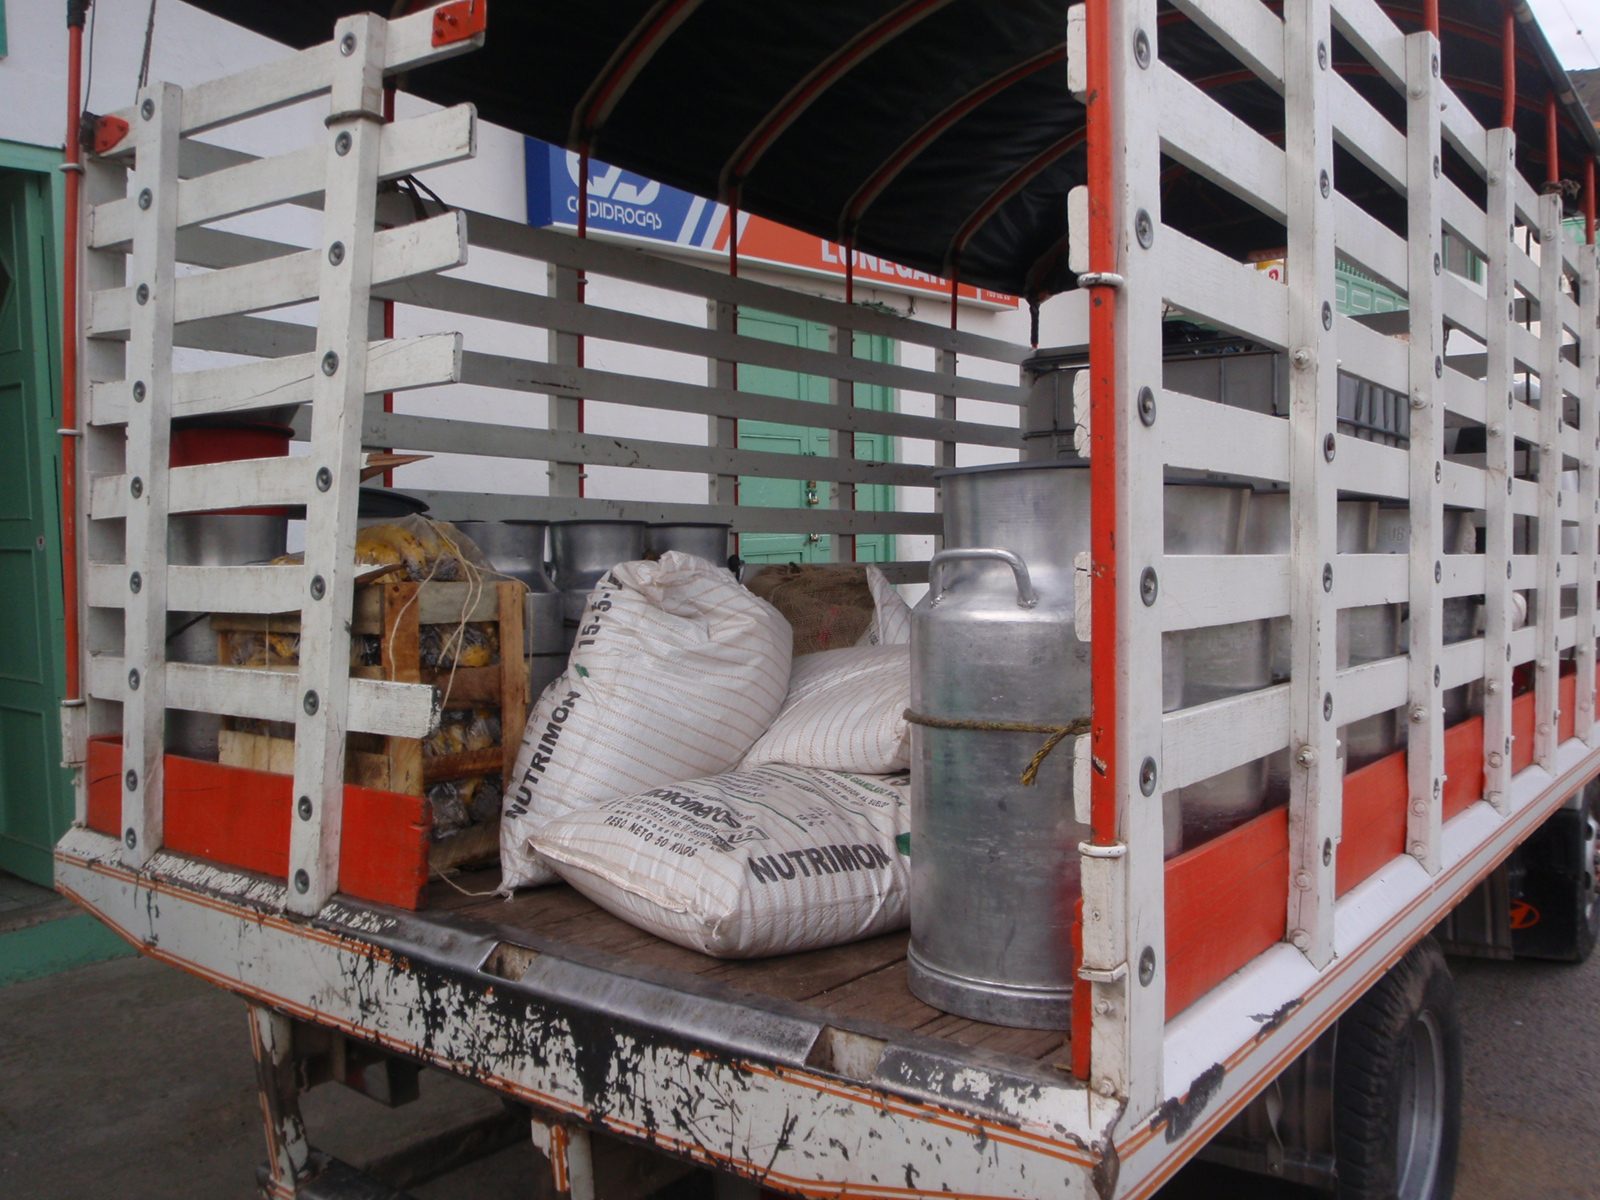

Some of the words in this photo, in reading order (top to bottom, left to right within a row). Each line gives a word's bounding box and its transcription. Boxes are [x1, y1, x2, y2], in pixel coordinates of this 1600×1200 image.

[567, 195, 662, 230] CPIDROGAS
[504, 690, 581, 820] NUTRIMON
[603, 815, 628, 829] PESO
[628, 822, 653, 842] NETO
[654, 835, 669, 848] 50
[747, 843, 893, 884] NUTRIMON
